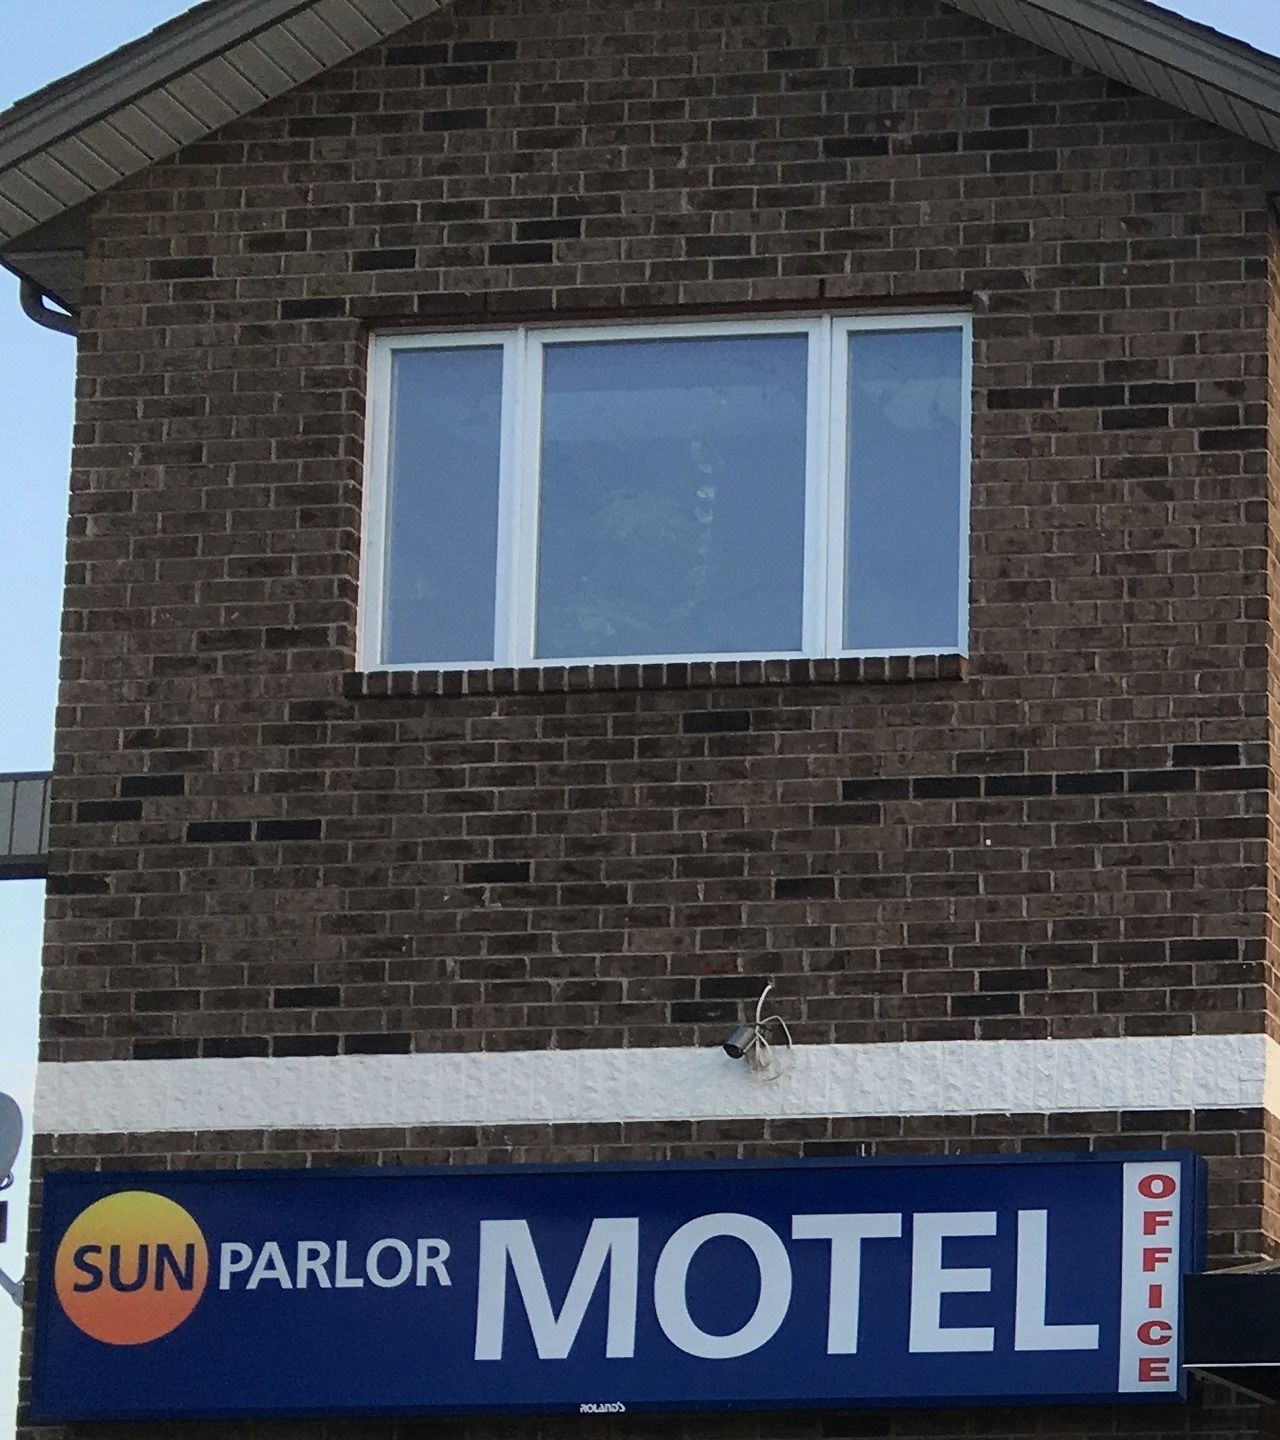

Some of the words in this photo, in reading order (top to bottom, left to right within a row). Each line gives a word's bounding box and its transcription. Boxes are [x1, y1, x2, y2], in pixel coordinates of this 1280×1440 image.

[72, 1243, 196, 1293] SUN
[218, 1237, 453, 1291] PARLOR
[474, 1208, 1100, 1361] MOTEL
[1136, 1173, 1177, 1383] OFFICE
